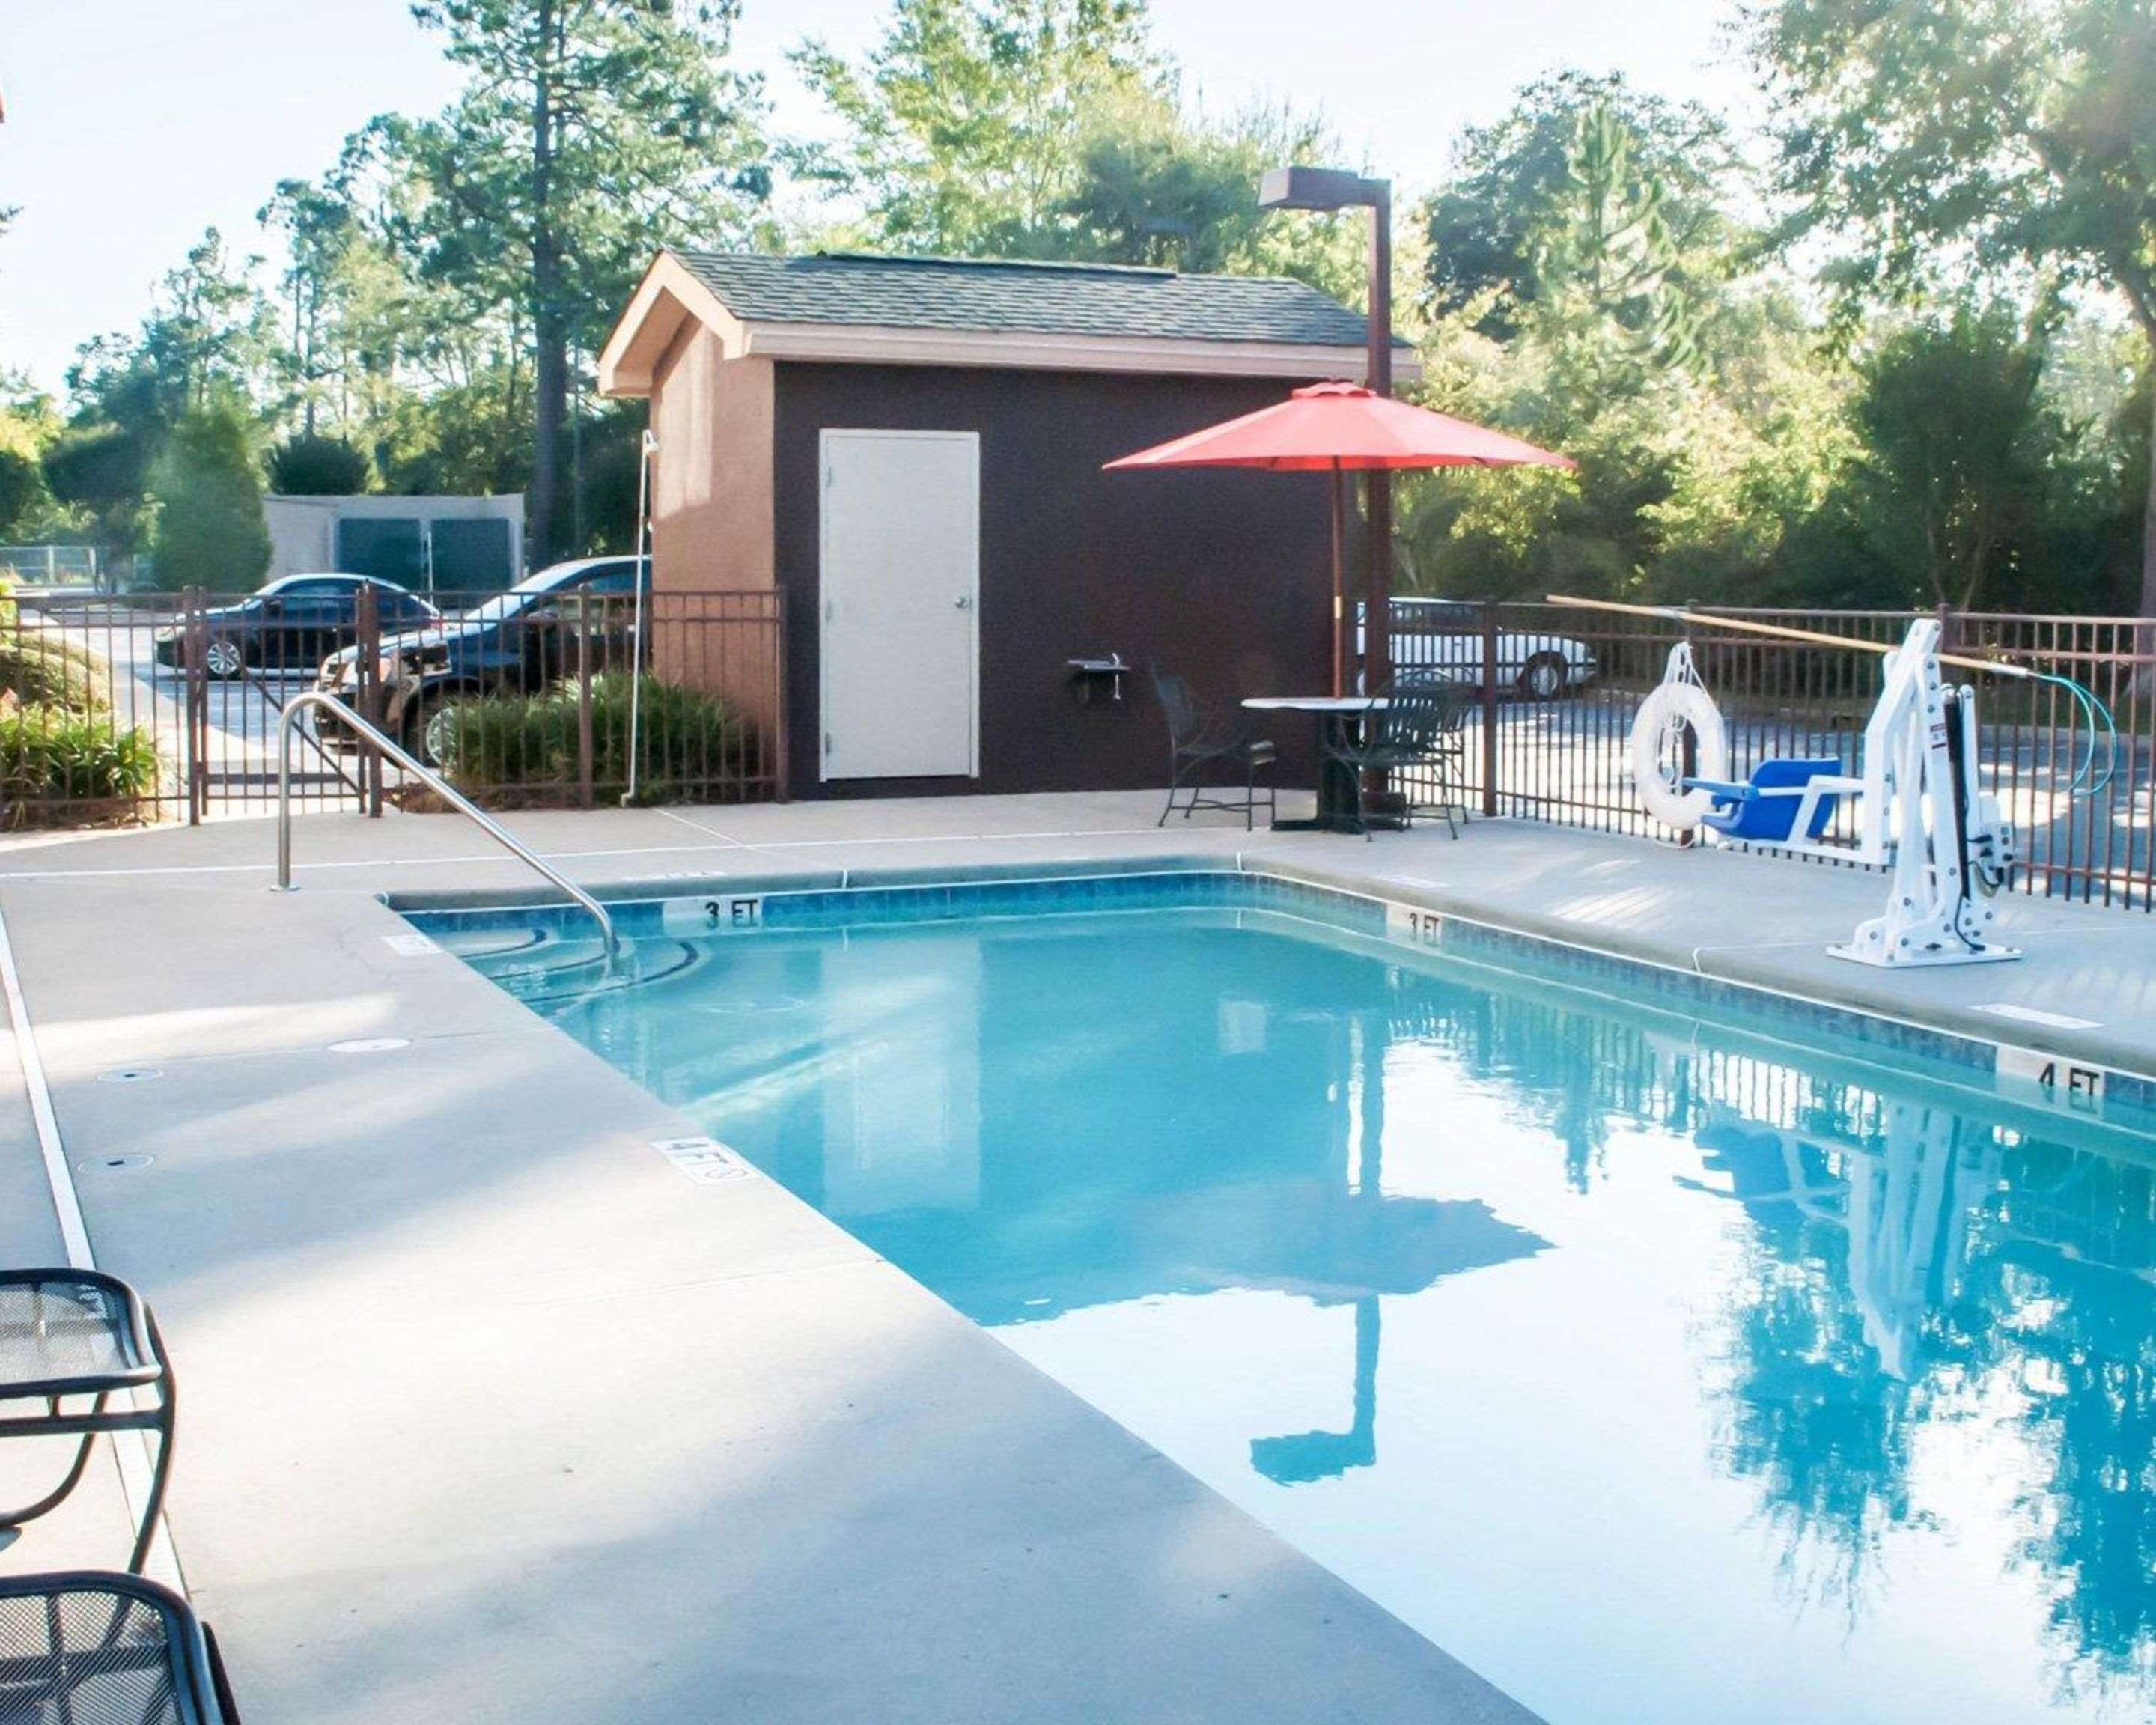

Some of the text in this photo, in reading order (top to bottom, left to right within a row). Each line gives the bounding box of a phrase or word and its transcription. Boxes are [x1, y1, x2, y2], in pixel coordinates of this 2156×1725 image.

[704, 899, 759, 918] 3 FT
[1424, 915, 1440, 934] FT
[2039, 1062, 2100, 1096] 4 FT
